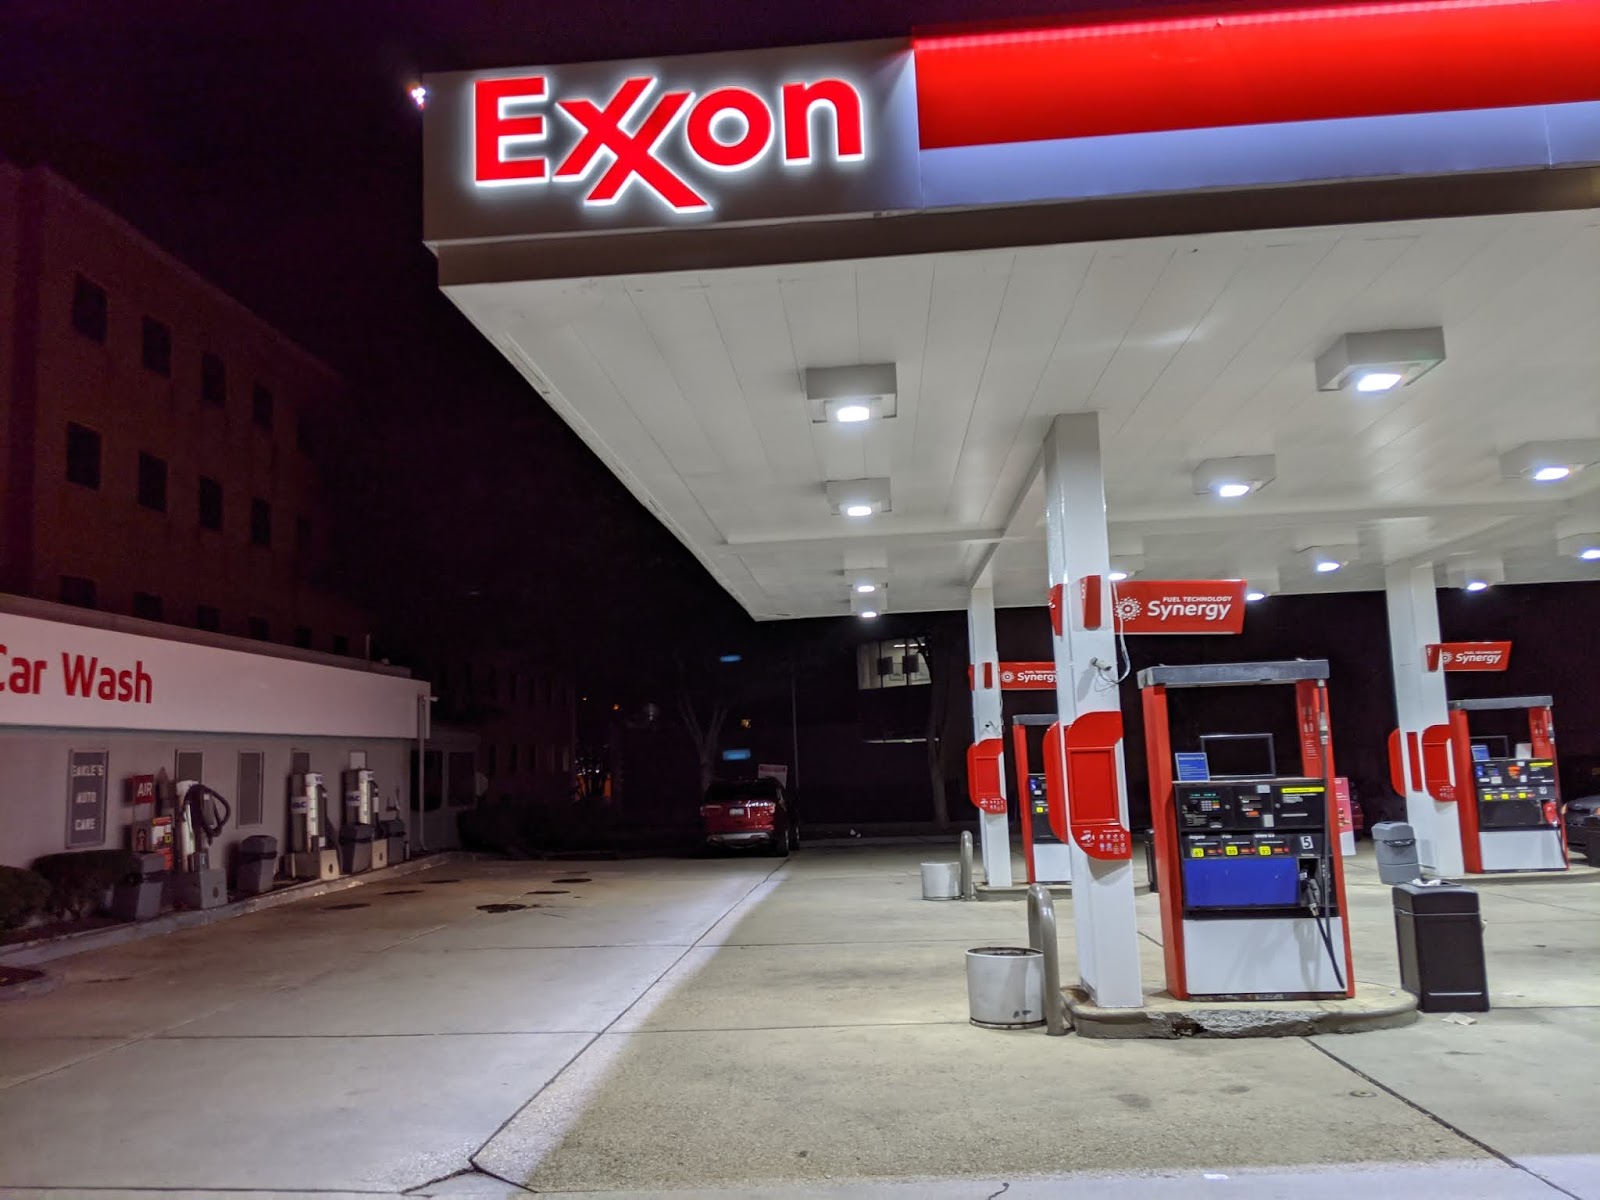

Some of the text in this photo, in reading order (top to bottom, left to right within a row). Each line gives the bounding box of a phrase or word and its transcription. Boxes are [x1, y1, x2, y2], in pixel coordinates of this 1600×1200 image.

[474, 75, 864, 213] Exxon
[1147, 600, 1231, 621] Synergy
[1455, 653, 1501, 664] Synergy
[61, 652, 152, 703] Wash
[1017, 672, 1057, 683] Synerg
[137, 782, 153, 797] AIR
[75, 791, 97, 803] AUTO
[75, 818, 96, 831] CARE
[1302, 837, 1311, 848] 5
